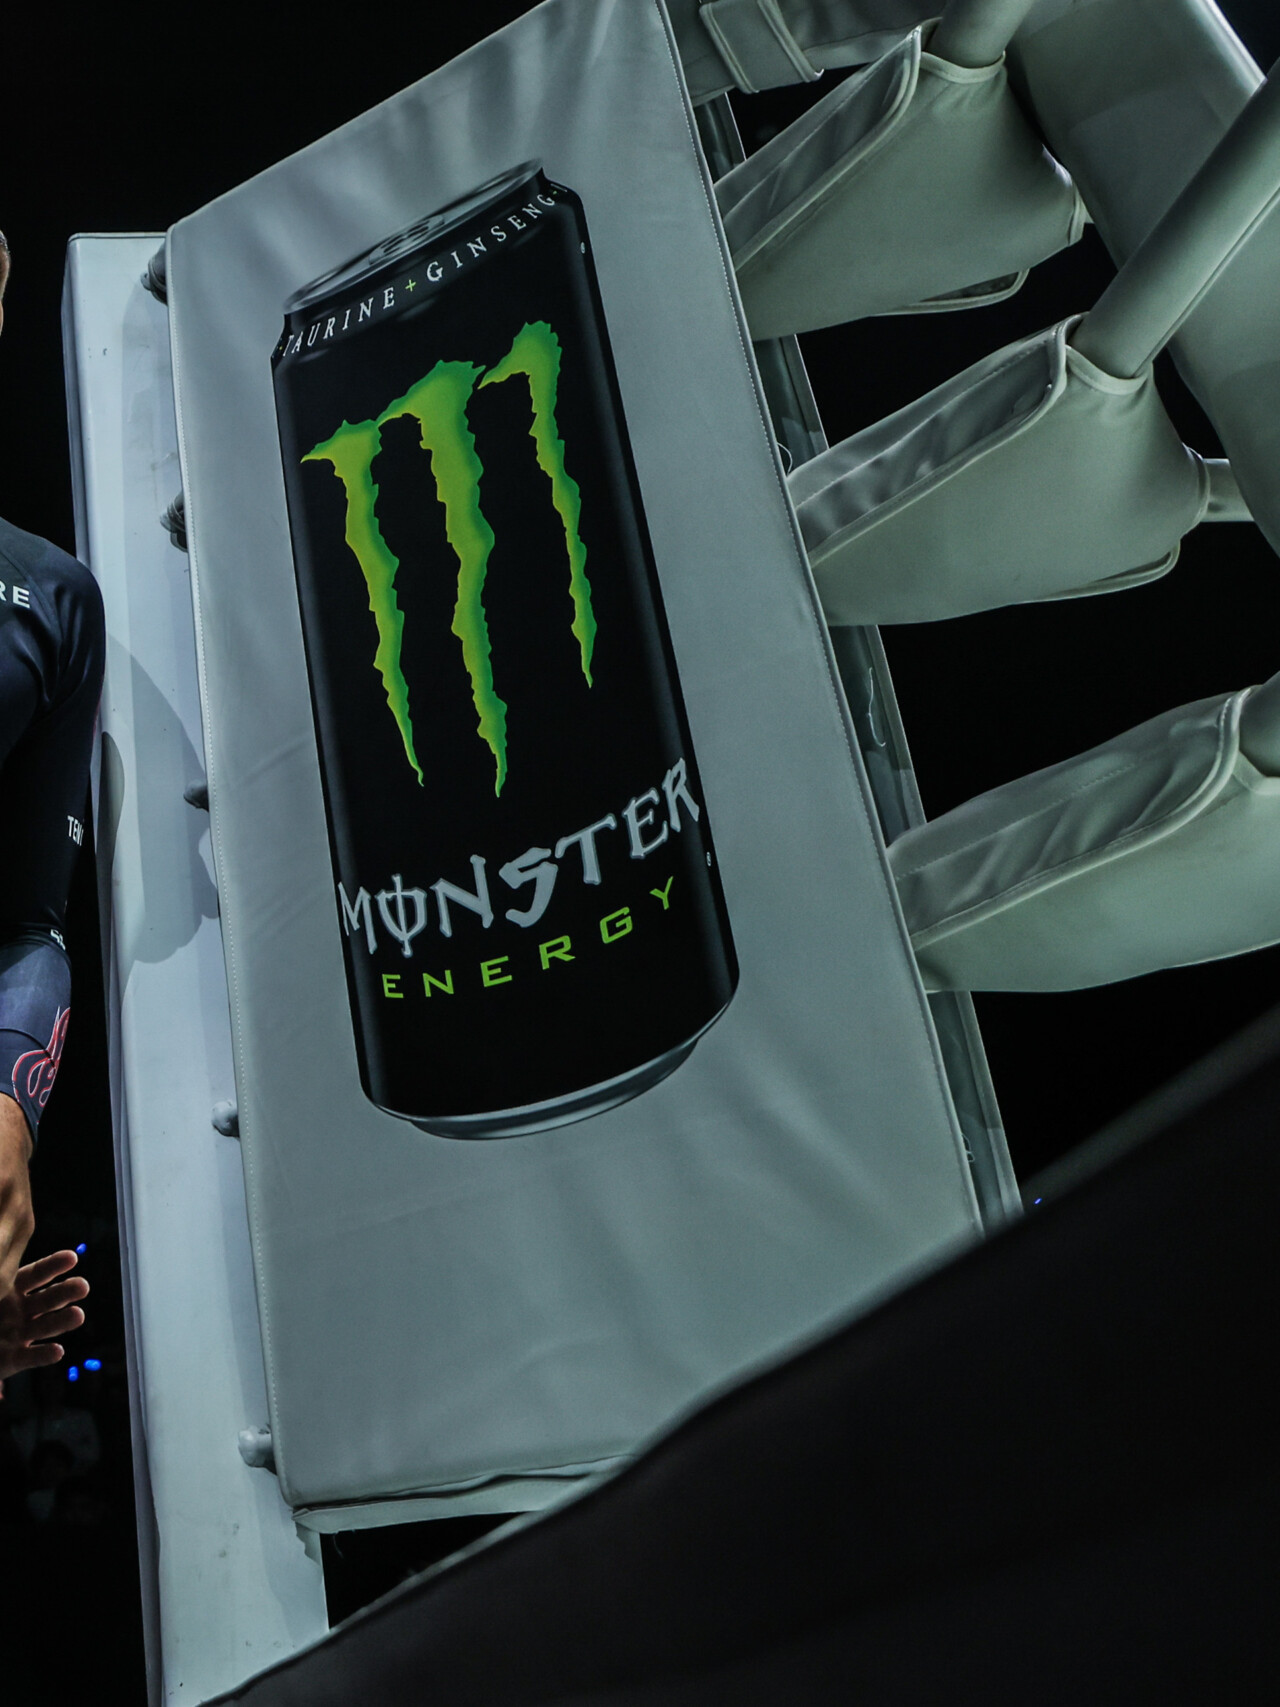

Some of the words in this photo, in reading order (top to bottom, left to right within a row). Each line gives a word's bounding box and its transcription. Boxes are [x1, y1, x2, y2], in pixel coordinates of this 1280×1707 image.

[282, 287, 395, 357] TAURINE
[426, 193, 556, 283] GINSENG
[336, 757, 701, 959] MONSTER
[381, 874, 675, 1000] ENERGY
